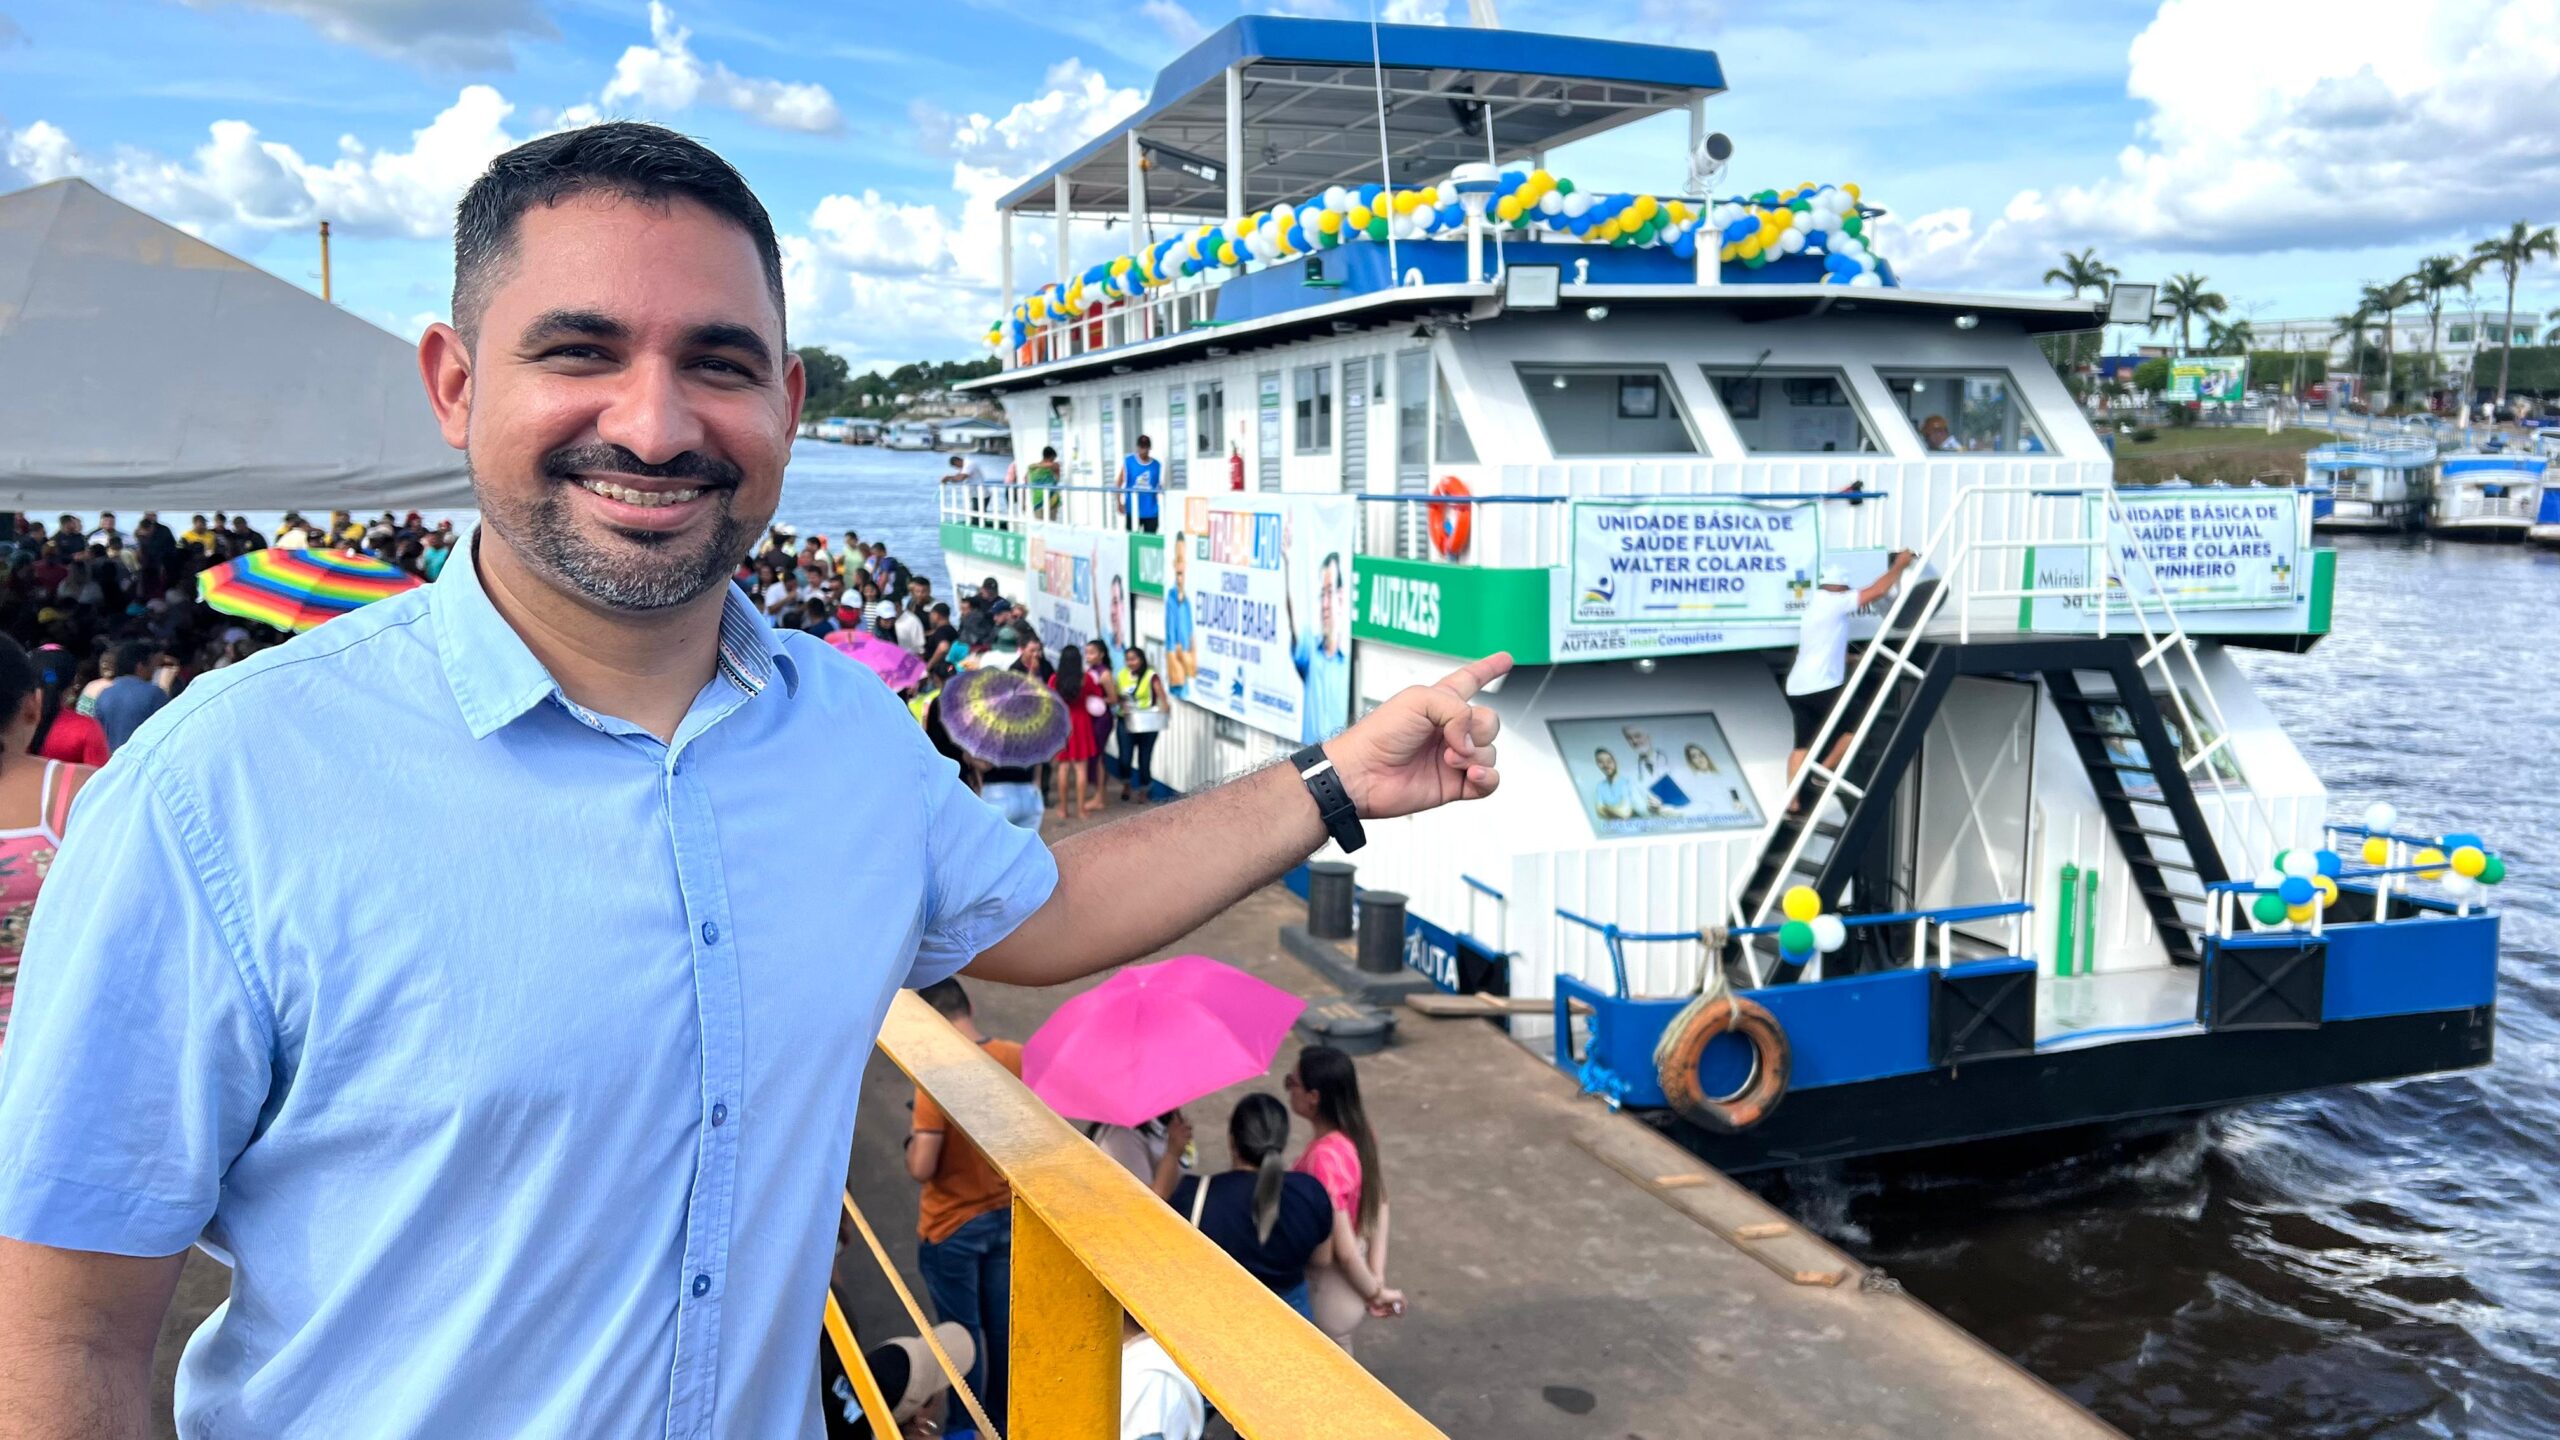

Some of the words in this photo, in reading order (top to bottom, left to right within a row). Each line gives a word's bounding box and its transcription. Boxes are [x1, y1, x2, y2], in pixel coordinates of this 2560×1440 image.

[2191, 502, 2252, 520] BÁSICA
[2256, 505, 2277, 520] DE
[1598, 514, 1688, 531] UNIDADE
[1694, 509, 1763, 531] BÁSICA
[1768, 516, 1793, 531] DE
[1621, 531, 1688, 551] SAÚDE
[1694, 536, 1774, 551] FLUVIAL
[2191, 525, 2263, 540] FLUVIAL
[2194, 543, 2271, 558] COLARES
[1609, 557, 1690, 573] WALTER
[1697, 556, 1786, 572] COLARES
[2155, 562, 2235, 577] PINHEIRO
[1651, 577, 1744, 594] PINHEIRO
[1369, 573, 1440, 638] AUTAZES
[1560, 637, 1626, 652] AUTAZES
[1408, 930, 1460, 993] AUTA
